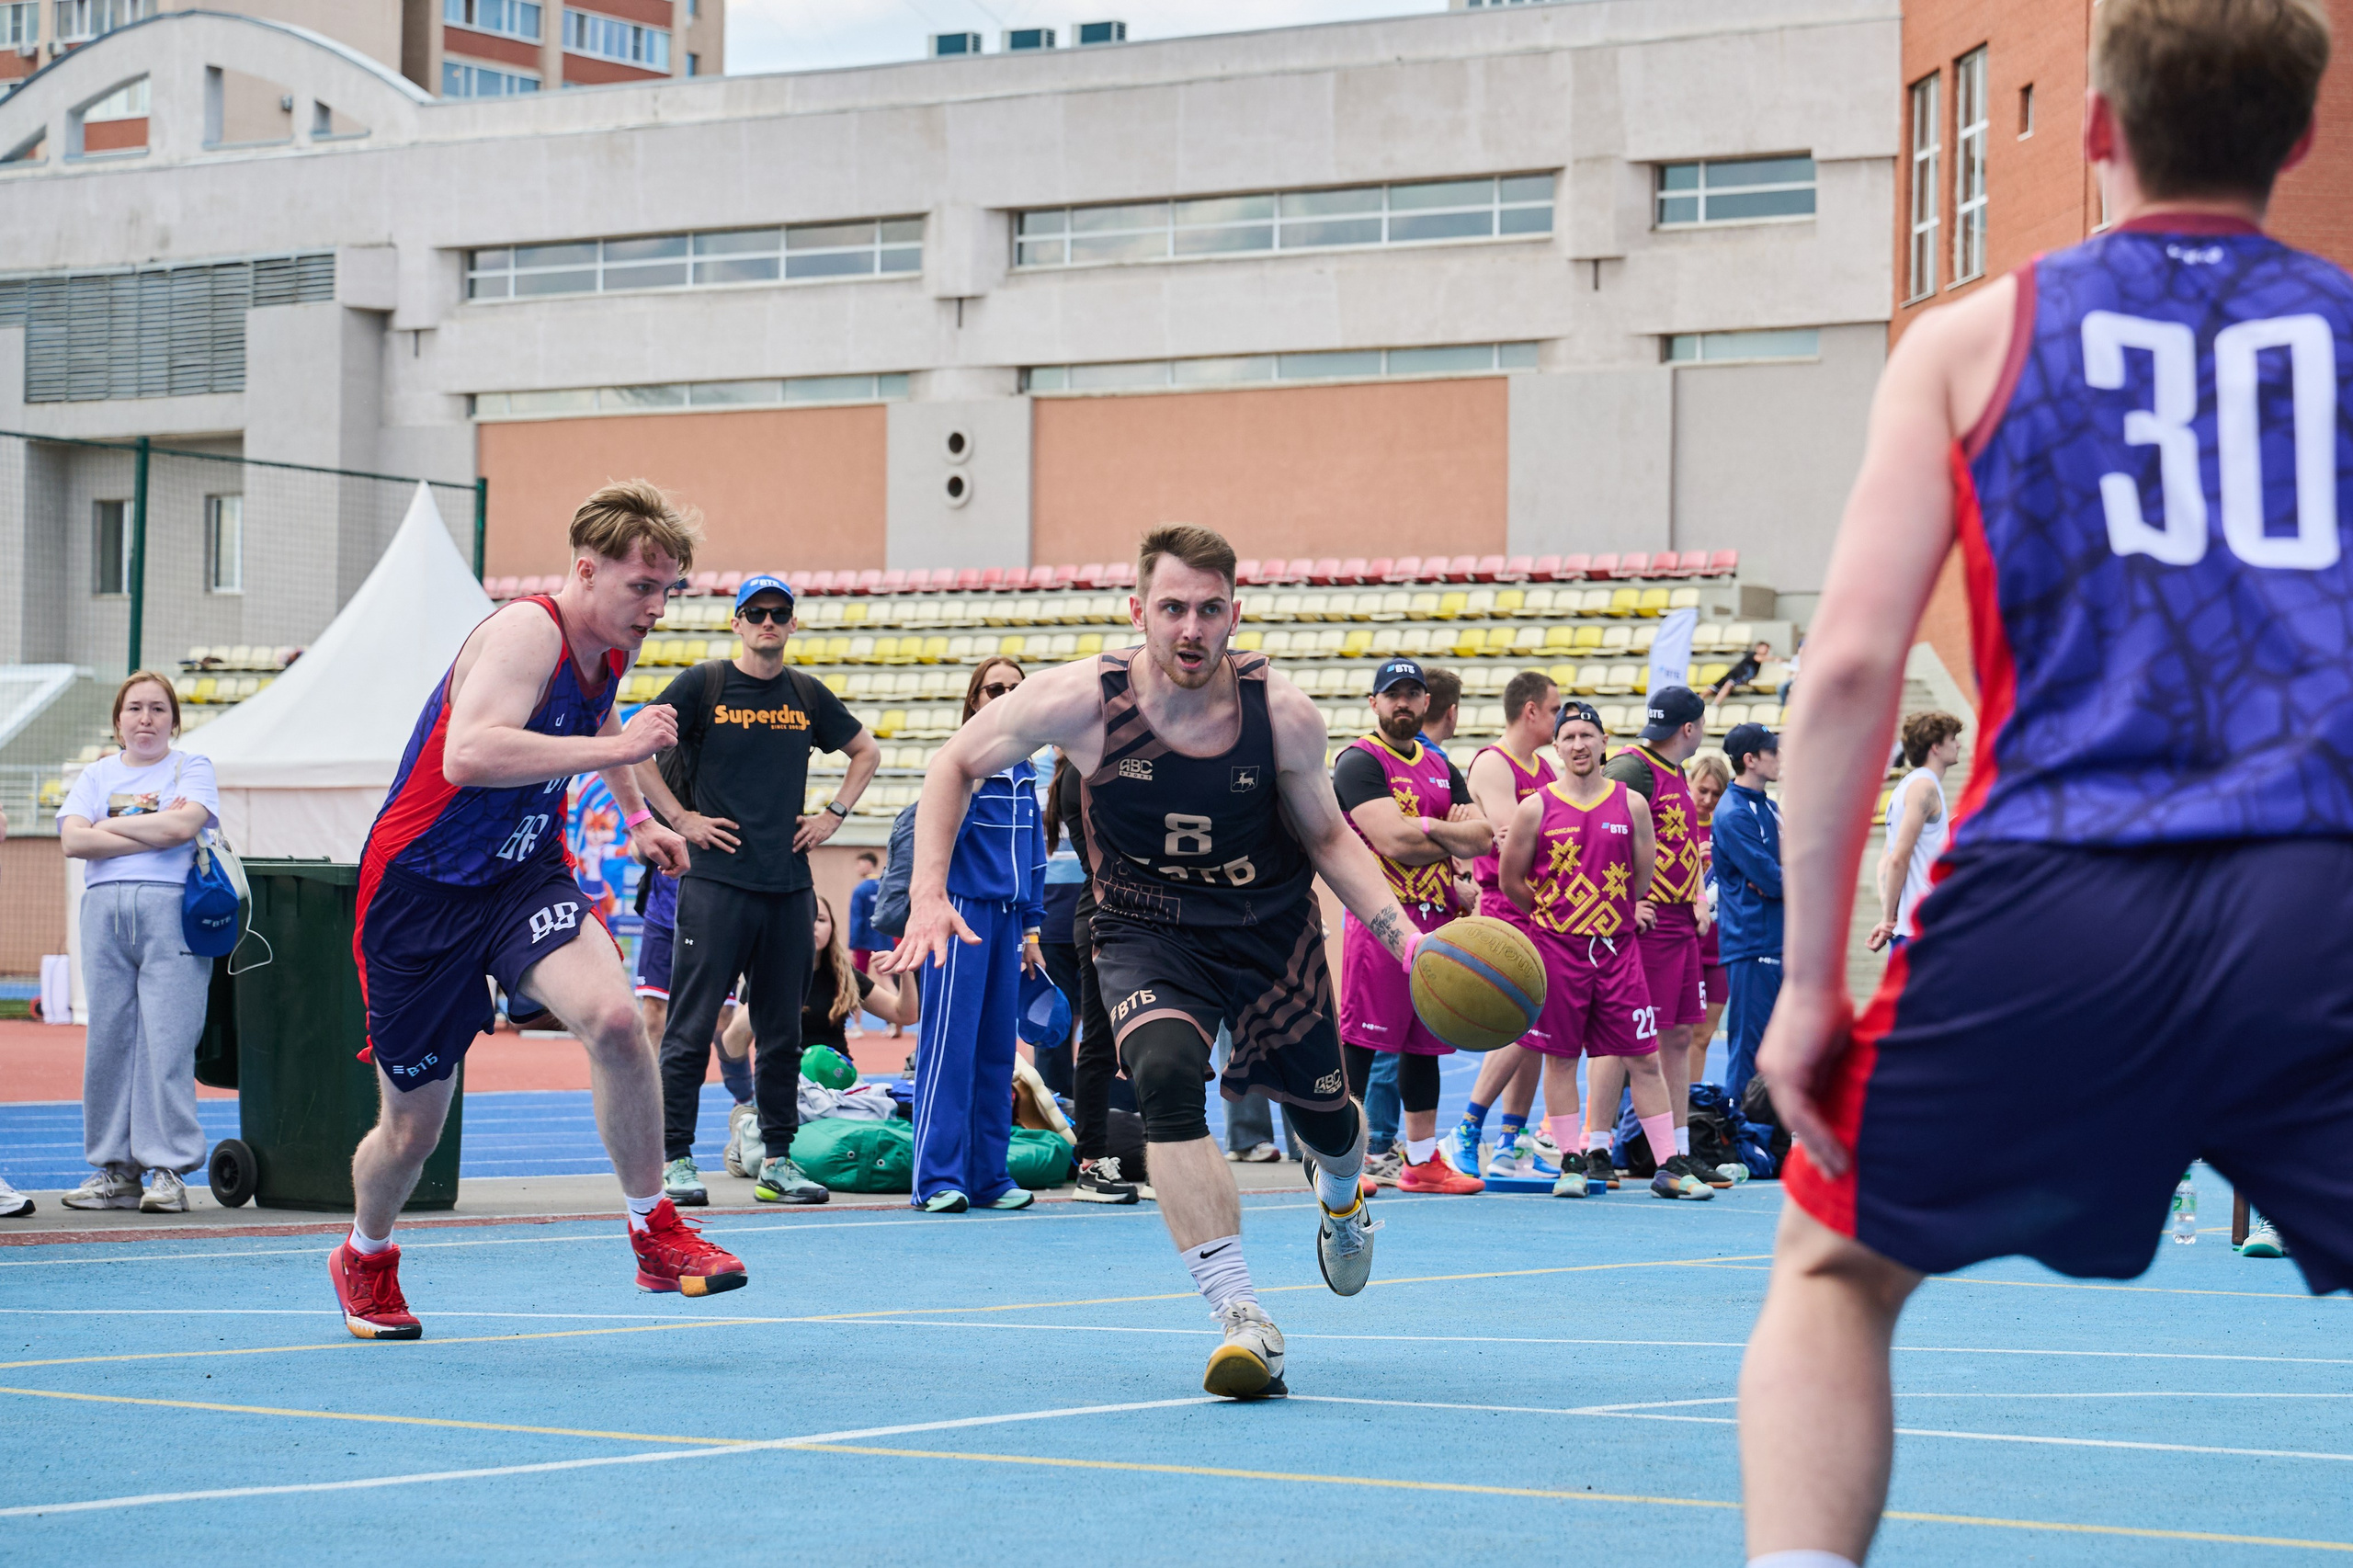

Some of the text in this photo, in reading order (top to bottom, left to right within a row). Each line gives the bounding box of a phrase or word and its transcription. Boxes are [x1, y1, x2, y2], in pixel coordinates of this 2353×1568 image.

[2080, 309, 2340, 570] 30
[1395, 664, 1415, 675] ВТБ
[1119, 758, 1154, 775] ABC
[1164, 812, 1213, 857] 8
[1609, 824, 1629, 835] ВТБ
[529, 901, 580, 944] 88
[1465, 926, 1535, 979] molten
[1117, 989, 1157, 1021] ВТБ
[1631, 1005, 1658, 1040] 22
[405, 1051, 438, 1078] ВТБ
